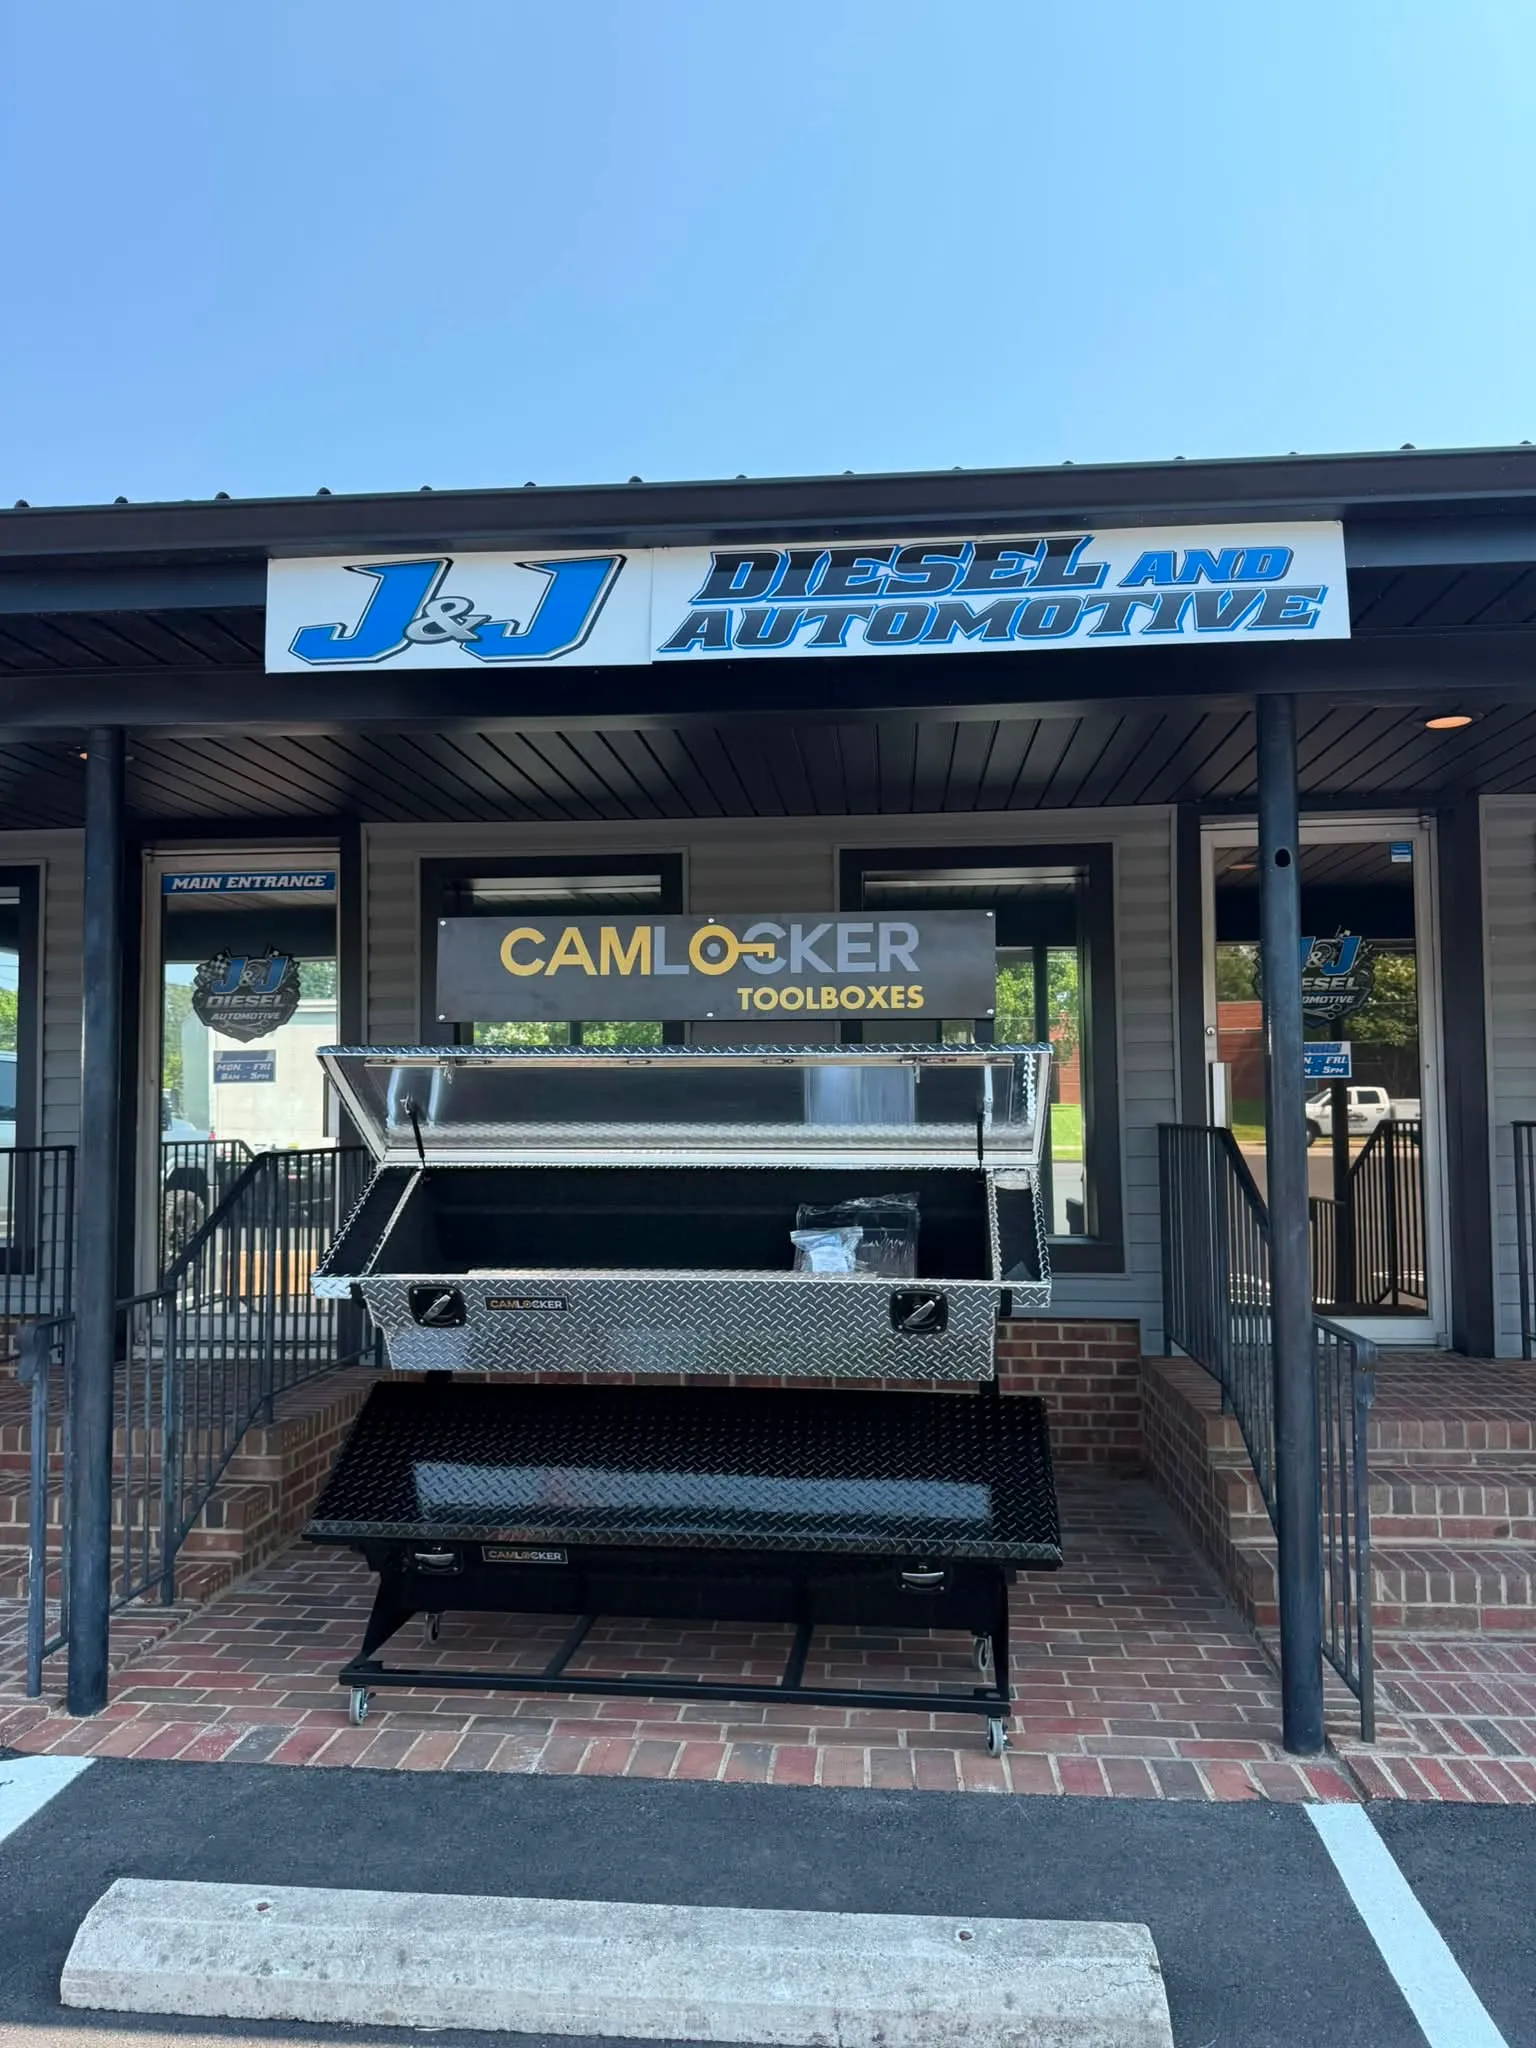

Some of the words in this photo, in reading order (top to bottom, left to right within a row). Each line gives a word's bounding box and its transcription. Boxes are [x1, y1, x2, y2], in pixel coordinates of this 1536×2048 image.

[690, 534, 1110, 605] DIESEL
[1116, 547, 1295, 588] AND
[288, 554, 627, 665] J&J
[657, 584, 1327, 653] AUTOMOTIVE
[171, 876, 221, 890] MAIN
[226, 874, 327, 889] ENTRANCE
[500, 921, 920, 977] CAMLOCKER
[212, 956, 288, 994] J&J
[1302, 977, 1360, 991] ESEL
[205, 994, 285, 1009] DIESEL
[737, 984, 925, 1011] TOOLBOXES
[1302, 995, 1355, 1004] OMOTIVE
[211, 1012, 281, 1021] AUTOMOTIVE
[490, 1299, 563, 1310] CAMLOCKER
[488, 1550, 562, 1561] CAMLOCKER
